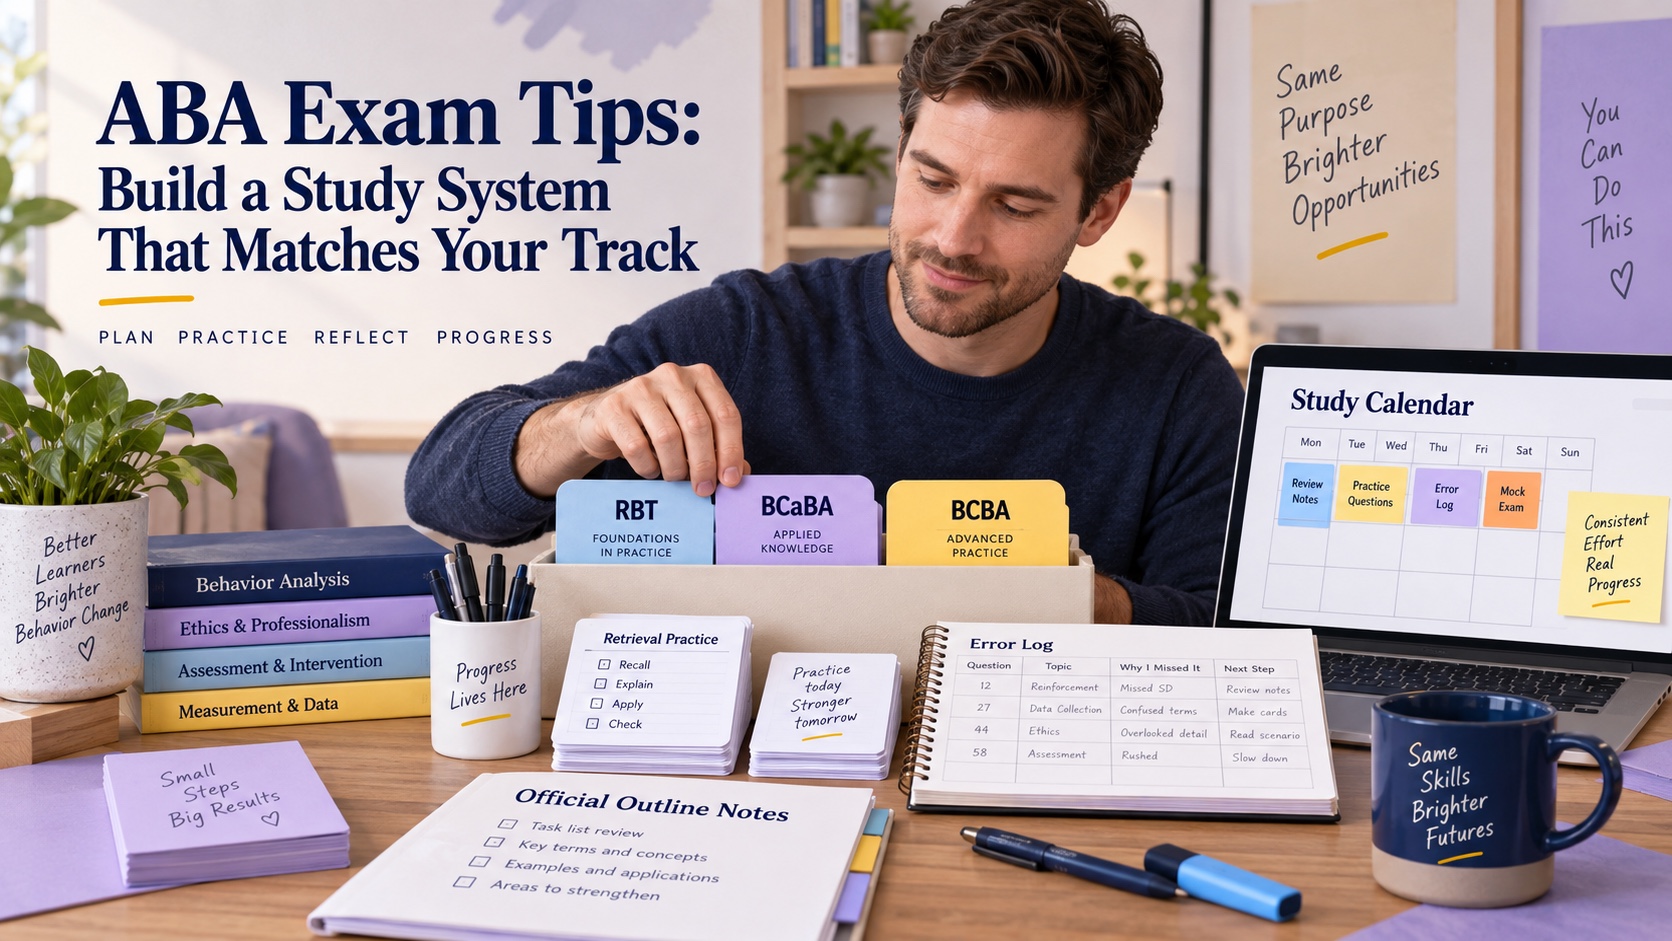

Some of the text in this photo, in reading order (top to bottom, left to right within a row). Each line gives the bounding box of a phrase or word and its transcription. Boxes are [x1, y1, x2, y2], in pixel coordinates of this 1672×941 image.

[1276, 63, 1342, 98] Same
[1279, 94, 1373, 140] Purpose
[1581, 97, 1620, 133] You
[1283, 133, 1387, 184] Brighter
[1581, 139, 1623, 169] Can
[1292, 159, 1440, 232] Opportunities
[1593, 176, 1621, 205] Do
[1581, 214, 1633, 248] This
[1291, 388, 1474, 417] Study Calendar
[1301, 438, 1321, 447] Mon
[1349, 440, 1366, 449] Tue
[1385, 440, 1407, 450] Wed
[1429, 442, 1448, 452] Thu
[1475, 444, 1488, 454] Fri
[1516, 446, 1532, 455] Sat
[1561, 447, 1579, 457] Sun
[1292, 478, 1323, 489] Review
[1353, 480, 1390, 492] Practice
[1435, 483, 1459, 494] Error
[1501, 486, 1526, 497] Mock
[1293, 494, 1318, 505] Notes
[1347, 496, 1393, 509] Questions
[1436, 499, 1454, 512] Log
[615, 499, 659, 521] RBT
[761, 496, 834, 517] BCaBA
[951, 499, 1010, 521] BCBA
[1499, 502, 1524, 513] Exam
[1584, 512, 1650, 531] Consistent
[593, 534, 680, 544] FOUNDATIONS
[773, 529, 821, 539] APPLIED
[946, 534, 1013, 544] ADVANCED
[43, 531, 97, 557] Better
[761, 543, 834, 554] KNOWLEDGE
[1584, 534, 1623, 551] Effort
[601, 548, 672, 558] IN PRACTICE
[952, 548, 1008, 558] PRACTICE
[35, 552, 105, 585] Learners
[1586, 556, 1614, 572] Real
[196, 571, 350, 593] Behavior Analysis
[1588, 575, 1641, 596] Progress
[35, 582, 101, 613] Brighter
[15, 600, 129, 643] Behavior Change
[180, 613, 371, 636] Ethics & Professionalism
[603, 632, 719, 646] Retrieval Practice
[970, 638, 1053, 653] Error Log
[178, 653, 383, 679] Assessment & Intervention
[456, 657, 517, 684] Progress
[619, 659, 650, 670] Recall
[967, 662, 1011, 671] Question
[1045, 662, 1072, 672] Topic
[1120, 664, 1142, 673] Why
[1154, 664, 1189, 672] Missed
[1192, 664, 1200, 673] It
[1224, 665, 1274, 675] Next Step
[793, 664, 851, 679] Practice
[616, 678, 653, 691] Explain
[806, 679, 841, 694] today
[980, 682, 991, 690] 12
[1031, 682, 1098, 692] Reinforcement
[1120, 684, 1173, 693] Missed SD
[1226, 685, 1291, 695] Review notes
[451, 681, 528, 710] Lives Here
[178, 697, 339, 720] Measurement & Data
[612, 698, 643, 711] Apply
[791, 695, 852, 713] Stronger
[977, 703, 991, 712] 27
[1029, 705, 1102, 714] Data Collection
[1120, 706, 1198, 716] Confused terms
[1228, 707, 1287, 717] Make cards
[609, 718, 642, 730] Check
[794, 712, 857, 729] tomorrow
[974, 725, 989, 734] 44
[1029, 727, 1060, 736] Ethics
[1120, 728, 1208, 739] Overlooked detail
[1230, 730, 1300, 740] Read scenario
[973, 748, 987, 757] 58
[1028, 750, 1087, 760] Assessment
[1121, 750, 1158, 761] Rushed
[1232, 753, 1288, 763] Slow down
[1408, 741, 1458, 767] Same
[161, 762, 216, 788] Small
[1420, 766, 1470, 793] Skills
[184, 779, 240, 803] Steps
[169, 790, 280, 829] Big Results
[514, 787, 790, 822] Official Outline Notes
[1412, 794, 1488, 824] Brighter
[531, 821, 644, 838] Task list review
[1426, 822, 1494, 850] Futures
[518, 840, 708, 864] Key terms and concepts
[504, 859, 719, 886] Examples and applications
[489, 879, 660, 901] Areas to strengthen
